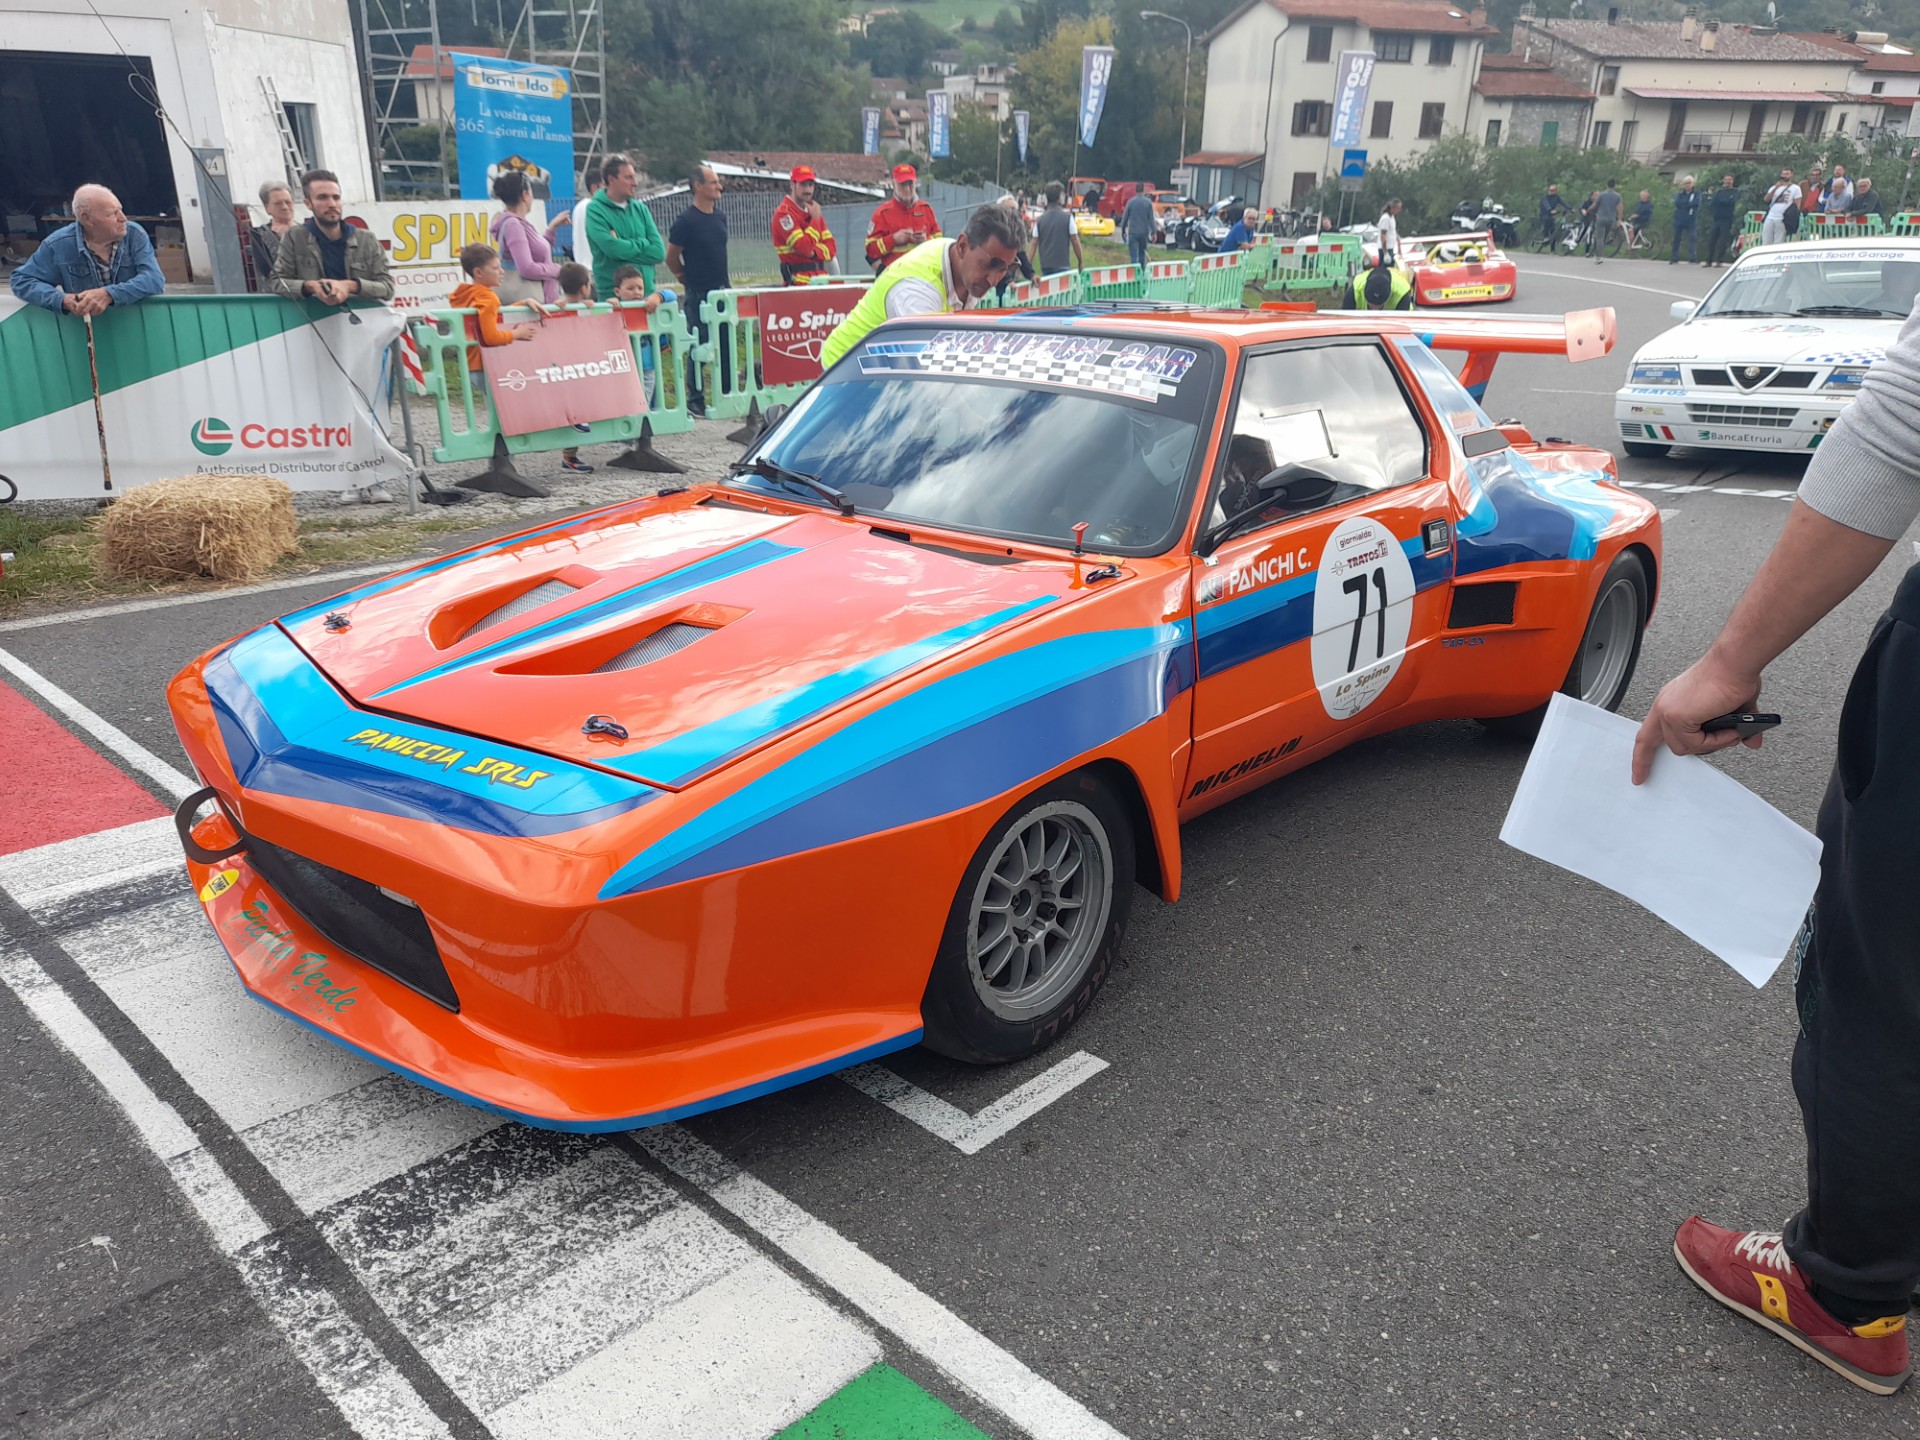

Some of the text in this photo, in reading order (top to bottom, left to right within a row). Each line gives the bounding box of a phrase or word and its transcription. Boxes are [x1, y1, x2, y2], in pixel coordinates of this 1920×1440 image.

[1334, 56, 1365, 142] TRATOS
[479, 102, 552, 125] La vostra casa
[932, 95, 943, 153] TRATOS
[457, 117, 572, 142] 365 giorni all'anno
[1825, 251, 1855, 260] Sport
[1857, 251, 1905, 259] Garage
[390, 296, 421, 308] AVI
[766, 308, 851, 331] Lo Spin
[766, 331, 812, 343] LEGGENDE
[921, 331, 1197, 382] EVOLUTION CAR
[535, 360, 612, 384] TRATOS
[1631, 388, 1687, 397] TRATOS
[240, 423, 352, 449] Castrol
[1710, 432, 1782, 444] BancaEtruria
[196, 462, 266, 475] Authorised
[269, 460, 337, 474] Distributor
[345, 456, 386, 473] Castrol
[1339, 531, 1372, 549] giornialdo
[1229, 547, 1312, 595] PANICHI C.
[1347, 548, 1380, 569] TRATOS
[1342, 567, 1388, 673] 71
[1335, 664, 1391, 698] Lo Spino
[342, 728, 555, 790] PANICCIA SRLS
[1186, 735, 1304, 800] MICHELIN
[292, 951, 358, 1012] Verde
[1031, 921, 1121, 1046] PIRELLI
